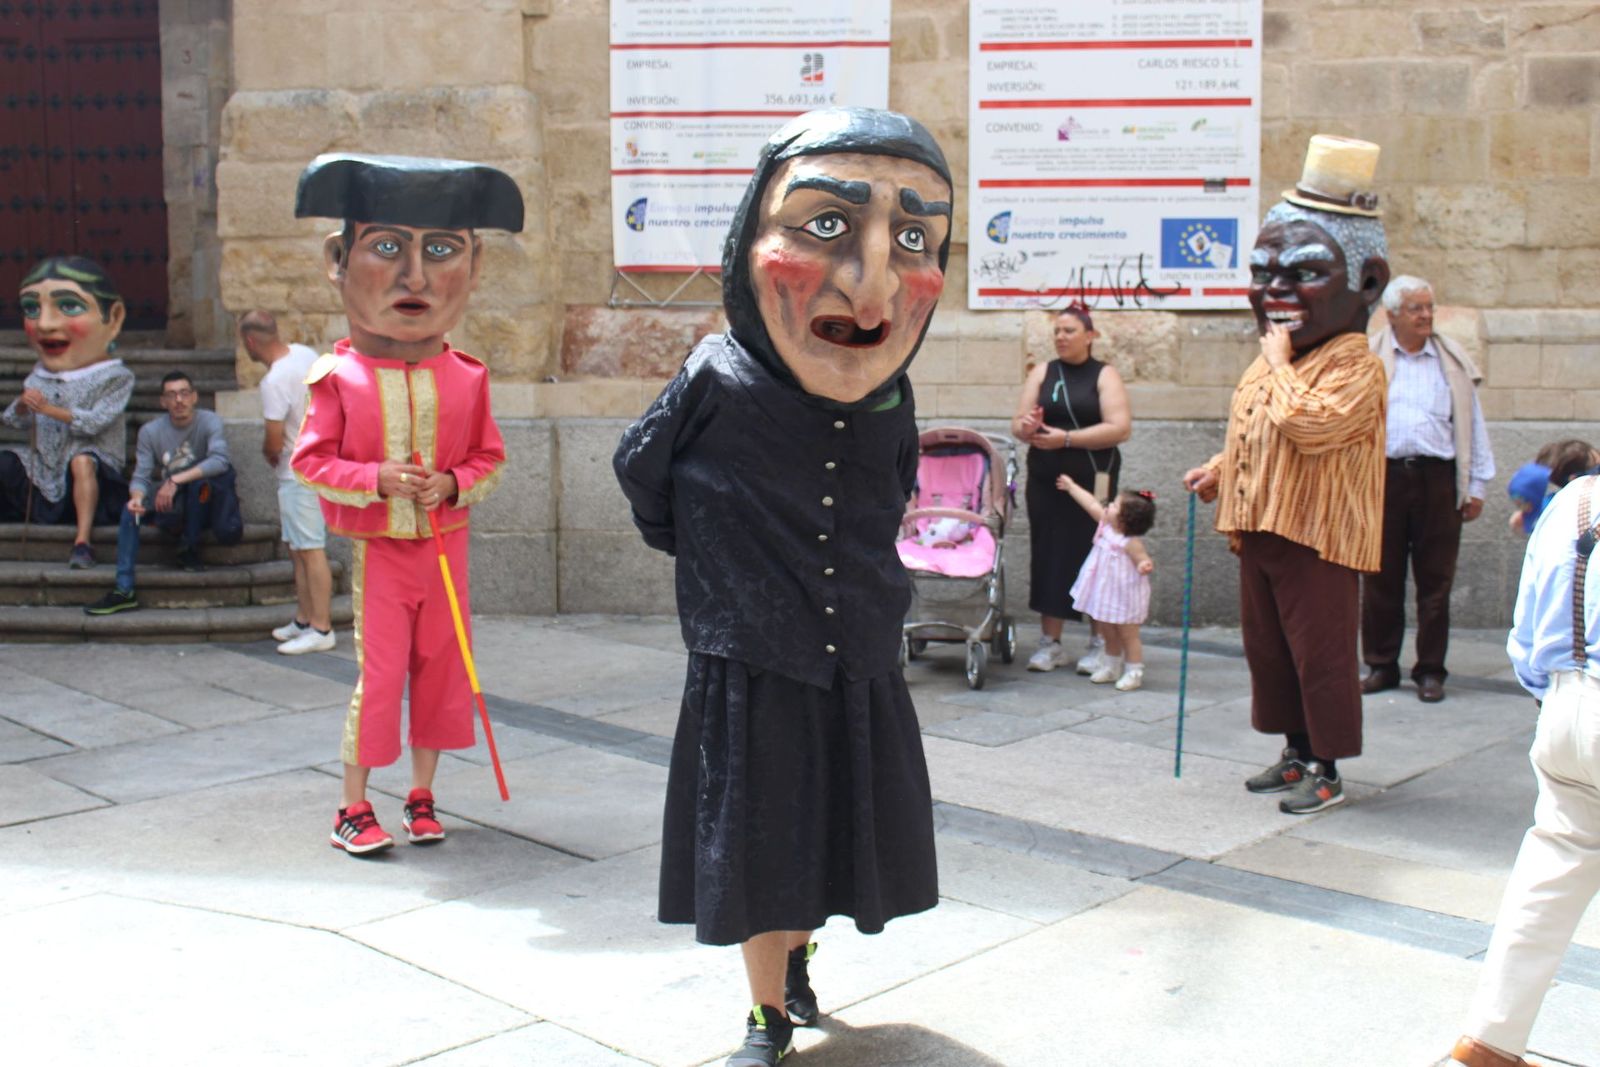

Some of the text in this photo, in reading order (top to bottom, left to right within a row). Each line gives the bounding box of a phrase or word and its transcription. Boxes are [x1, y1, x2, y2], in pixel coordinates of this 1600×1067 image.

[626, 58, 672, 71] EMPRESA:
[986, 60, 1038, 72] EMPRESA:
[1137, 57, 1179, 69] CARLOS
[1182, 57, 1220, 69] RIESCO
[986, 80, 1047, 93] INVERSIÓN:
[985, 121, 1044, 133] CONVENIO:
[648, 218, 730, 228] nuestro crecim
[1058, 215, 1105, 229] impulsa
[1010, 229, 1128, 240] nuestro crecimiento
